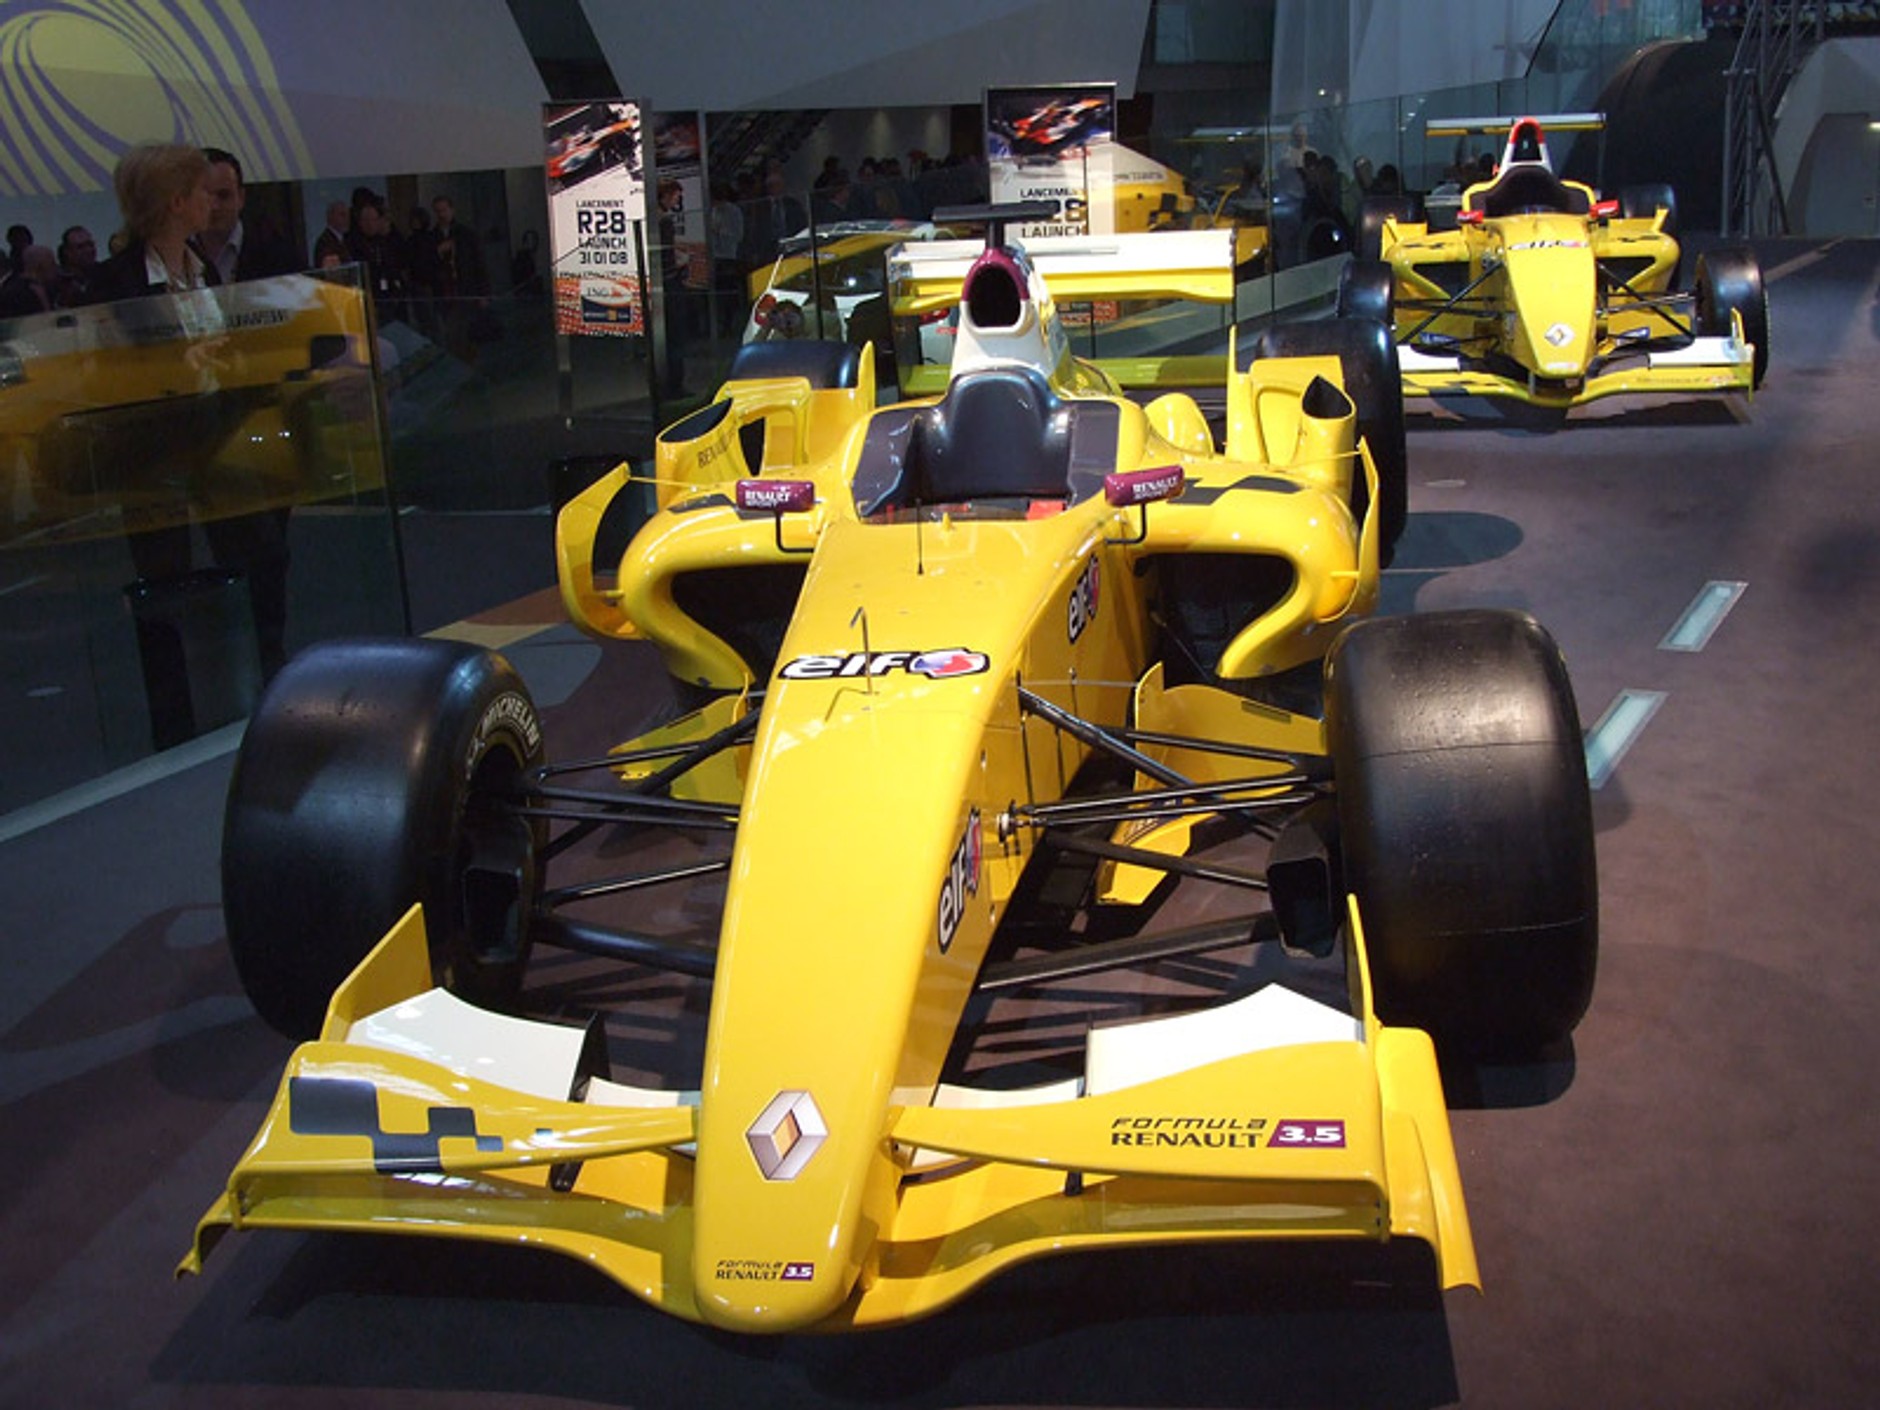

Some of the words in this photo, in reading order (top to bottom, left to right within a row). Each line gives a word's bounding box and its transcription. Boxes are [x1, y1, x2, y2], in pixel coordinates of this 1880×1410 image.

[576, 200, 624, 208] LANCEMENT
[577, 209, 626, 234] R28
[578, 236, 627, 249] LAUNCH
[1133, 476, 1177, 493] RENAULT
[745, 490, 791, 502] RENAULT
[779, 652, 914, 679] elf
[1110, 1132, 1264, 1148] RENAULT
[1278, 1125, 1342, 1143] 3.5
[715, 1270, 778, 1280] RENAULT
